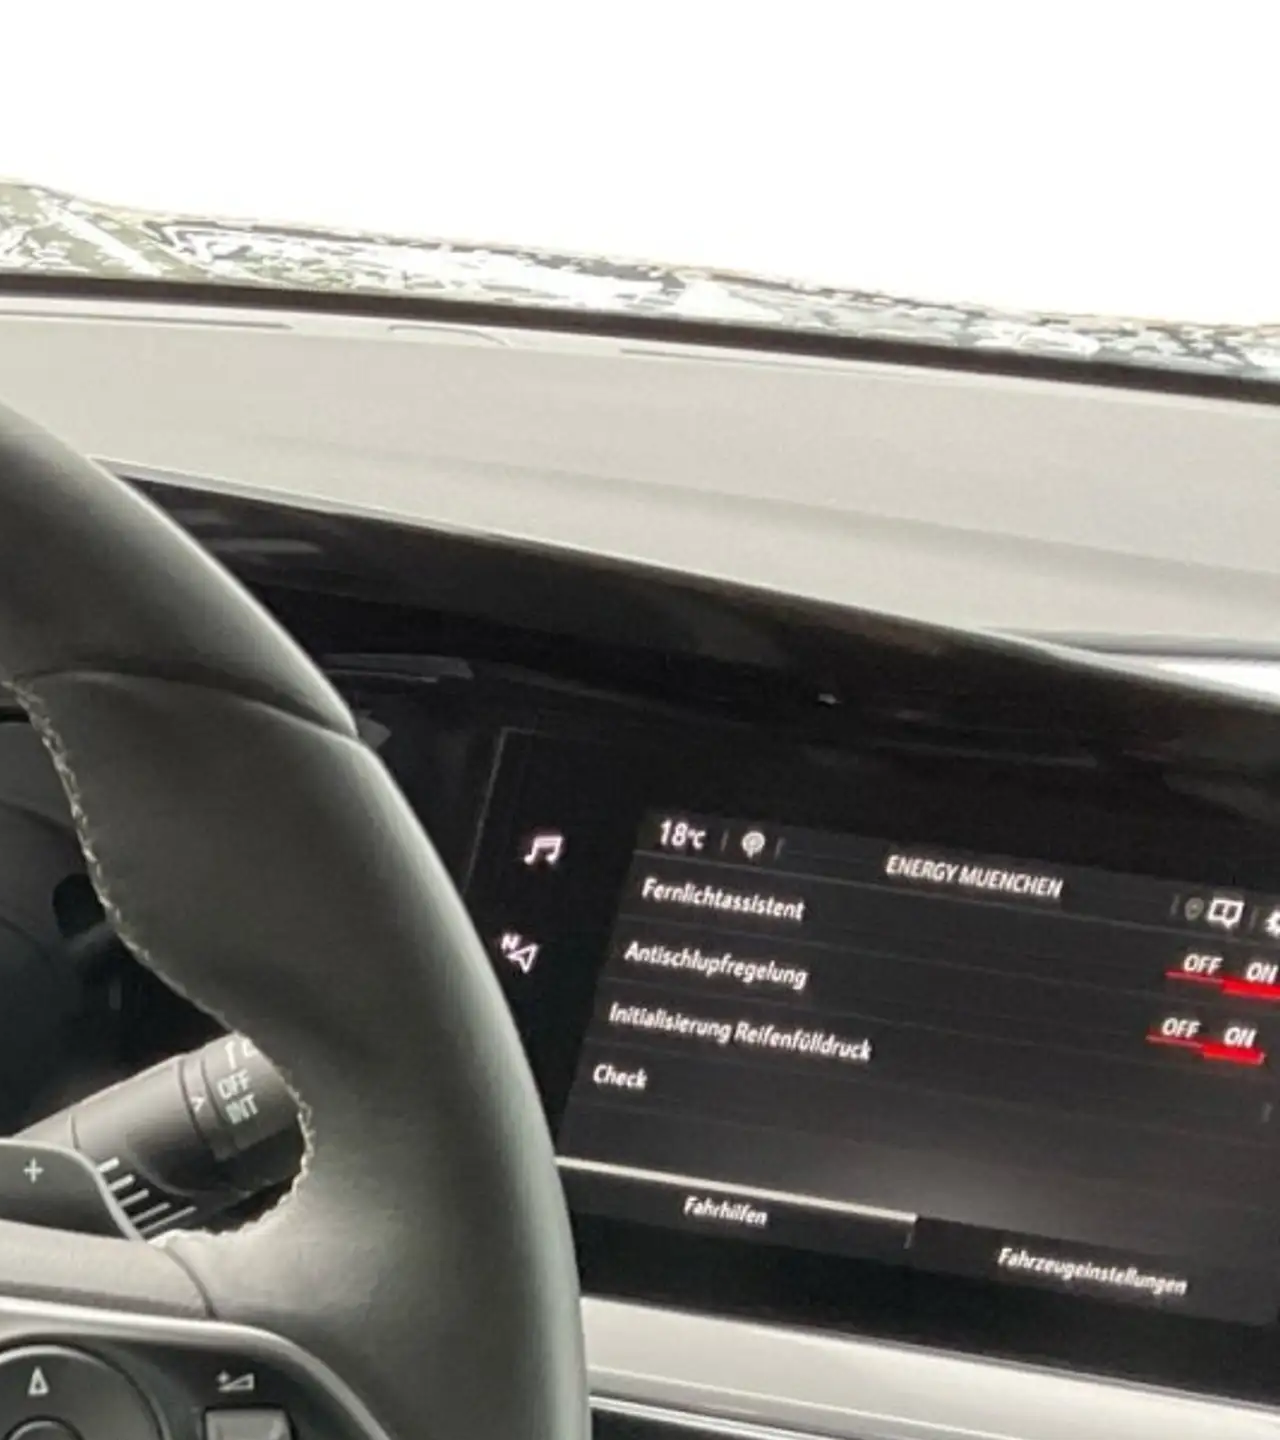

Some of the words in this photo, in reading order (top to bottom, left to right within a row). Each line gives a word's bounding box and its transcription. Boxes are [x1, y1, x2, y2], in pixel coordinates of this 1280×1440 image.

[885, 854, 959, 883] ENERGY
[958, 864, 1064, 899] MUENCHEN
[641, 875, 806, 922] Fernlichtassistent
[624, 940, 809, 992] Antischlupfregelung
[1183, 953, 1224, 976] OFF
[1245, 960, 1279, 985] ON
[608, 1001, 733, 1046] Initialisierung
[733, 1019, 873, 1063] Reifenfülldruck
[1161, 1016, 1202, 1040] OFF
[1223, 1025, 1258, 1049] ON
[217, 1067, 249, 1100] OFF
[592, 1063, 648, 1090] Check
[683, 1195, 768, 1227] Fahrhilfen
[997, 1246, 1189, 1298] Fahrzeugeinstellungen
